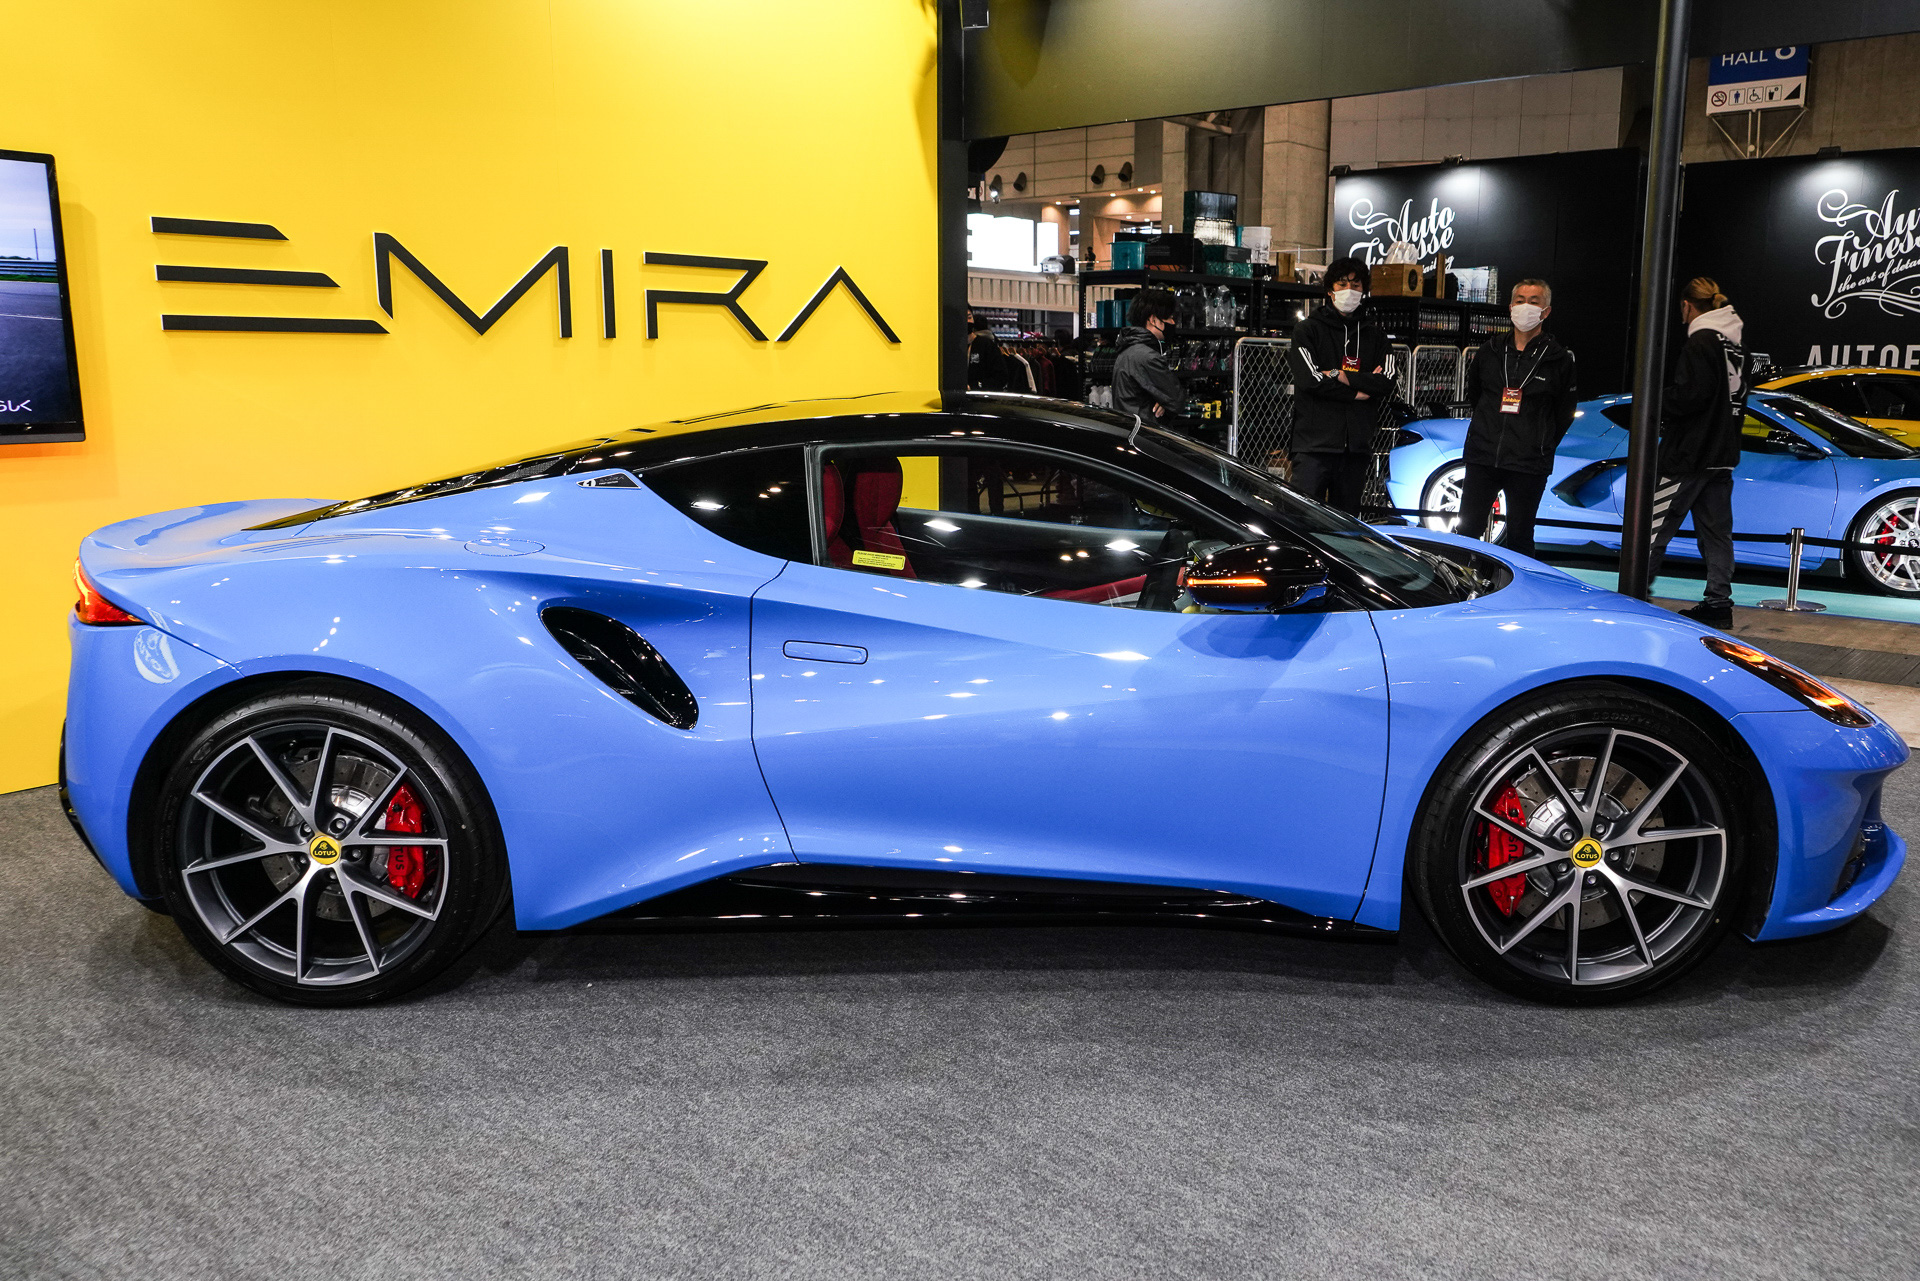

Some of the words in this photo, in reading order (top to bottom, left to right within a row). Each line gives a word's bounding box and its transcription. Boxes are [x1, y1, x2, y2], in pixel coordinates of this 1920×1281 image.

[1722, 50, 1768, 67] HALL
[1349, 198, 1455, 256] Auto
[1817, 188, 1920, 250] Au
[151, 216, 902, 343] EMIRA
[1838, 273, 1857, 293] the
[1858, 271, 1877, 287] art
[1878, 258, 1896, 287] of
